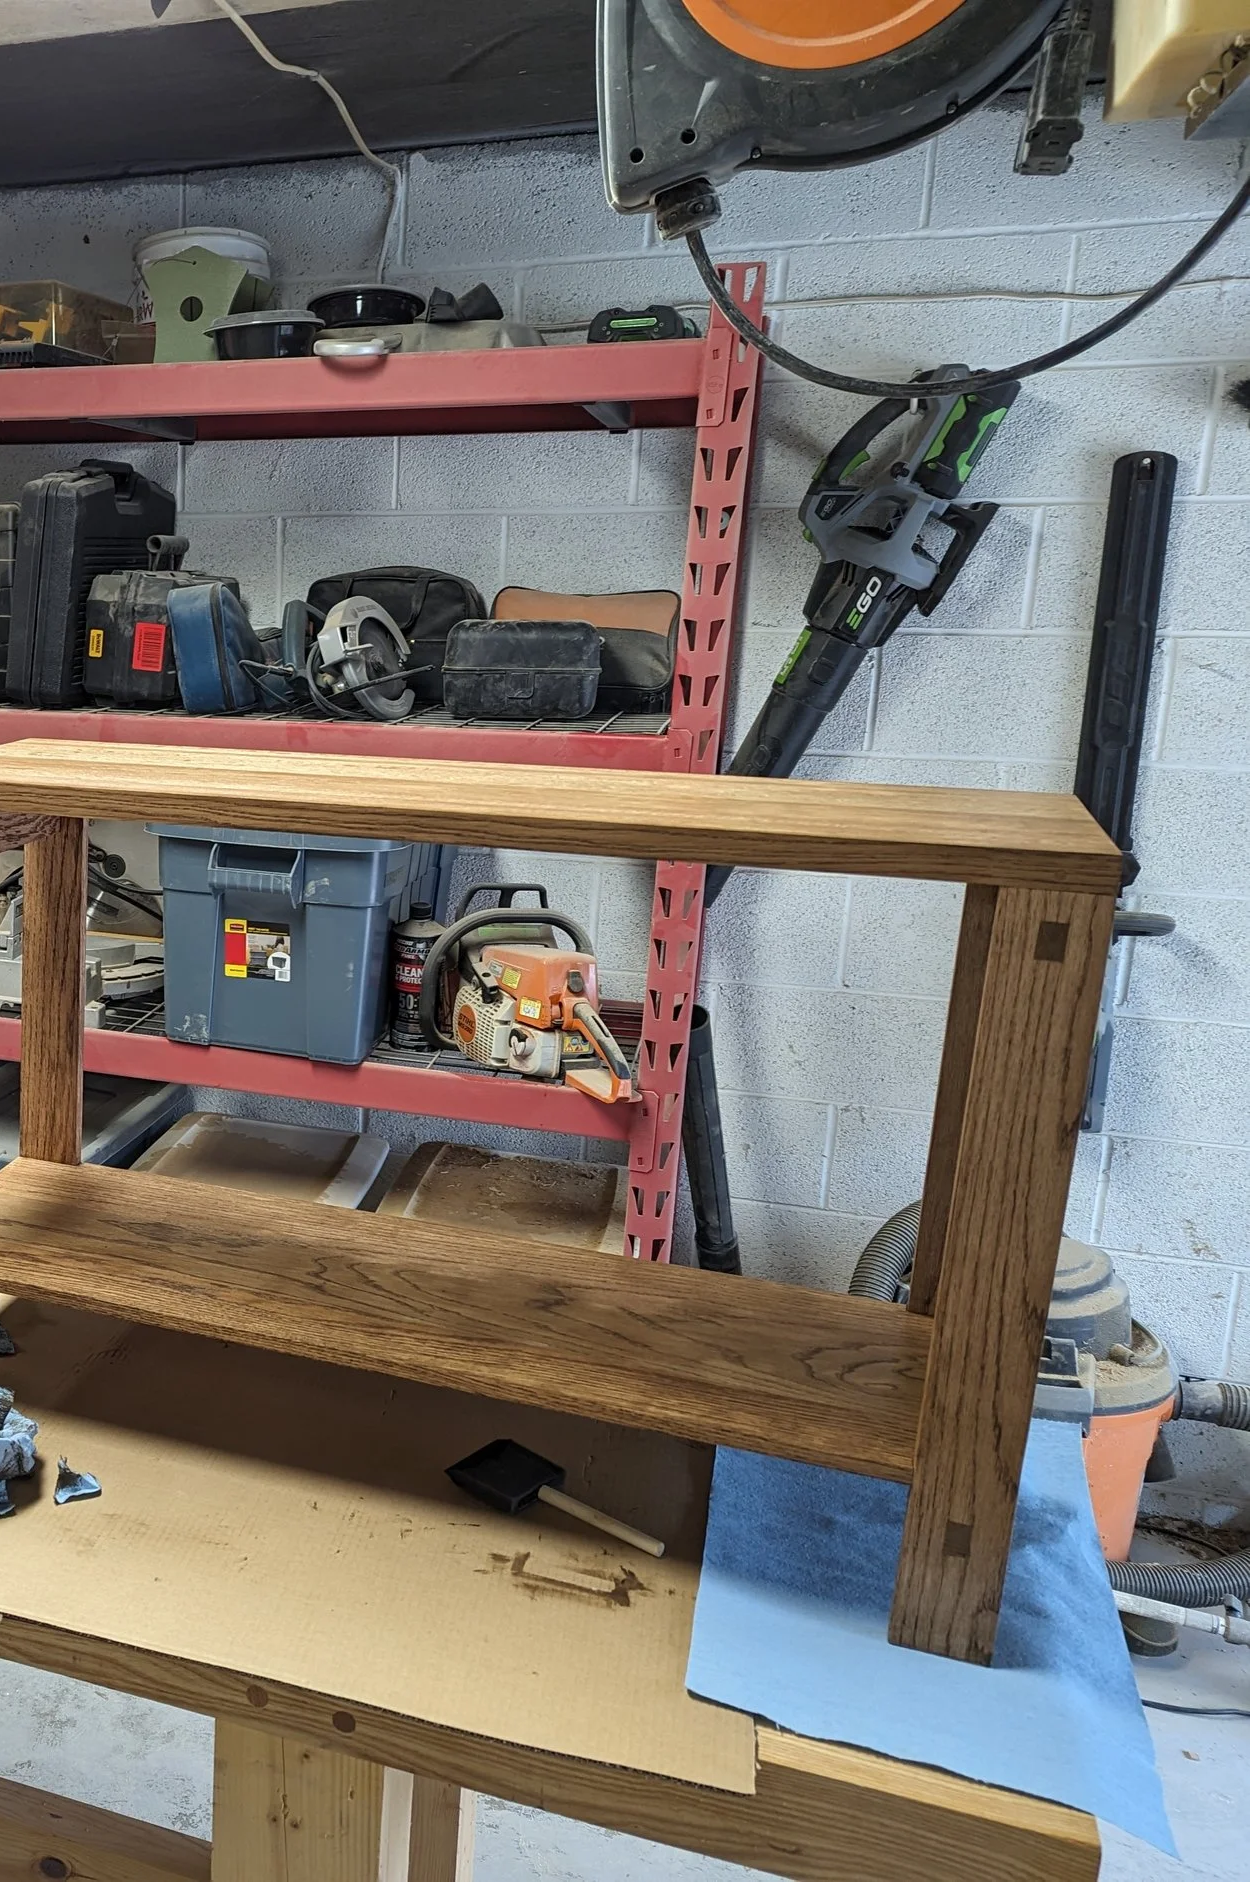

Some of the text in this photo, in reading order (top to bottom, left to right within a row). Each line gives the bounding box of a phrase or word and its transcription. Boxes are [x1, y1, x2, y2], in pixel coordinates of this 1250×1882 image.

[845, 576, 882, 630] EGO
[398, 992, 420, 1011] 50:
[458, 1013, 475, 1029] STIHL
